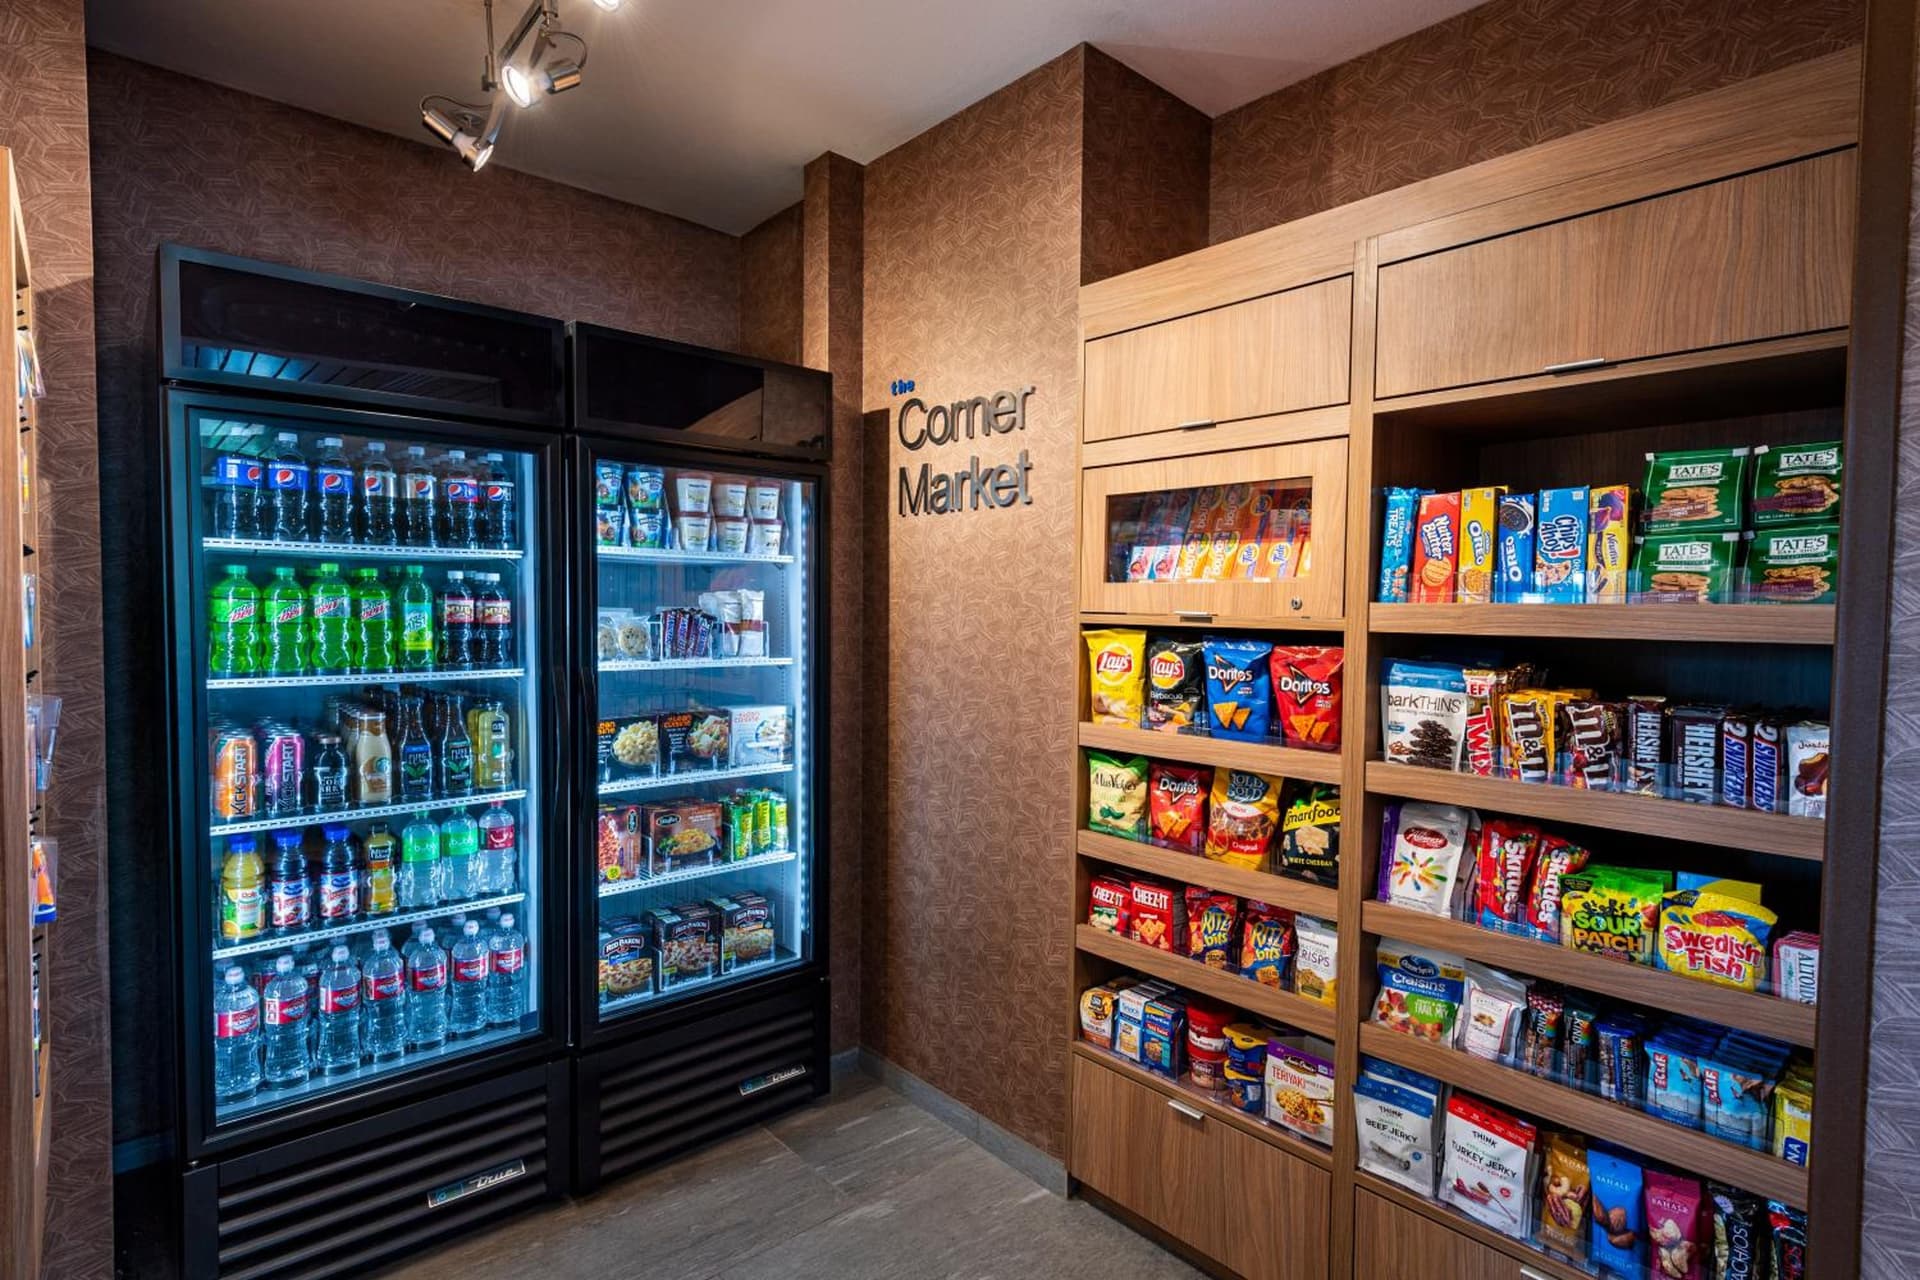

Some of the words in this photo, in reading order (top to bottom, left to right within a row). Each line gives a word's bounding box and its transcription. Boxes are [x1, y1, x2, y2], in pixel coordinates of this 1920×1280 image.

[891, 379, 915, 396] the
[898, 386, 1036, 450] Corner
[1671, 463, 1721, 476] TATE'S
[1784, 451, 1835, 465] TATE'S
[899, 449, 1033, 517] Market
[1386, 508, 1398, 547] TREATS
[1433, 514, 1454, 556] Nutter
[1552, 515, 1579, 550] Chips
[1272, 543, 1286, 563] Tide
[1422, 523, 1443, 561] Butter
[1467, 521, 1486, 566] OREO
[1662, 543, 1711, 557] TATE'S
[1773, 537, 1826, 551] TATE'S
[1242, 545, 1255, 563] Tide
[1505, 535, 1522, 582] OREO
[446, 605, 471, 615] MUG
[484, 606, 509, 616] MUG
[1208, 665, 1254, 682] Doritos
[1280, 676, 1331, 695] Doritos
[1723, 721, 1748, 738] 2
[1754, 722, 1778, 742] 2
[1466, 706, 1494, 777] TWIX
[1724, 735, 1746, 808] SNICKERS
[1754, 740, 1776, 812] SNICKERS
[1160, 778, 1199, 795] Doritos
[1232, 841, 1260, 852] Original
[1504, 839, 1527, 914] Skittles
[1538, 848, 1570, 924] Skittles
[1092, 885, 1124, 907] CHEEZ-IT
[1132, 886, 1169, 910] CHEEZ-IT
[1202, 910, 1232, 936] RITZ
[1574, 910, 1642, 937] SOUR
[618, 936, 643, 947] BARON
[1203, 931, 1228, 947] bits
[1250, 923, 1285, 949] RITZ
[1573, 928, 1646, 953] PATCH
[1663, 924, 1762, 967] Swedish
[1255, 944, 1281, 961] bits
[1686, 948, 1746, 983] Fish
[1391, 972, 1447, 993] Craisins
[1536, 1010, 1549, 1036] KIND
[1572, 1017, 1584, 1045] KIND
[1271, 1066, 1306, 1089] TERIYAKI
[1378, 1104, 1404, 1119] THINK
[1365, 1117, 1389, 1131] BEEF
[1389, 1127, 1419, 1143] JERKY
[1472, 1130, 1498, 1148] THINK
[1452, 1140, 1484, 1165] TURKEY
[1486, 1160, 1518, 1179] JERKY
[468, 1169, 519, 1189] True
